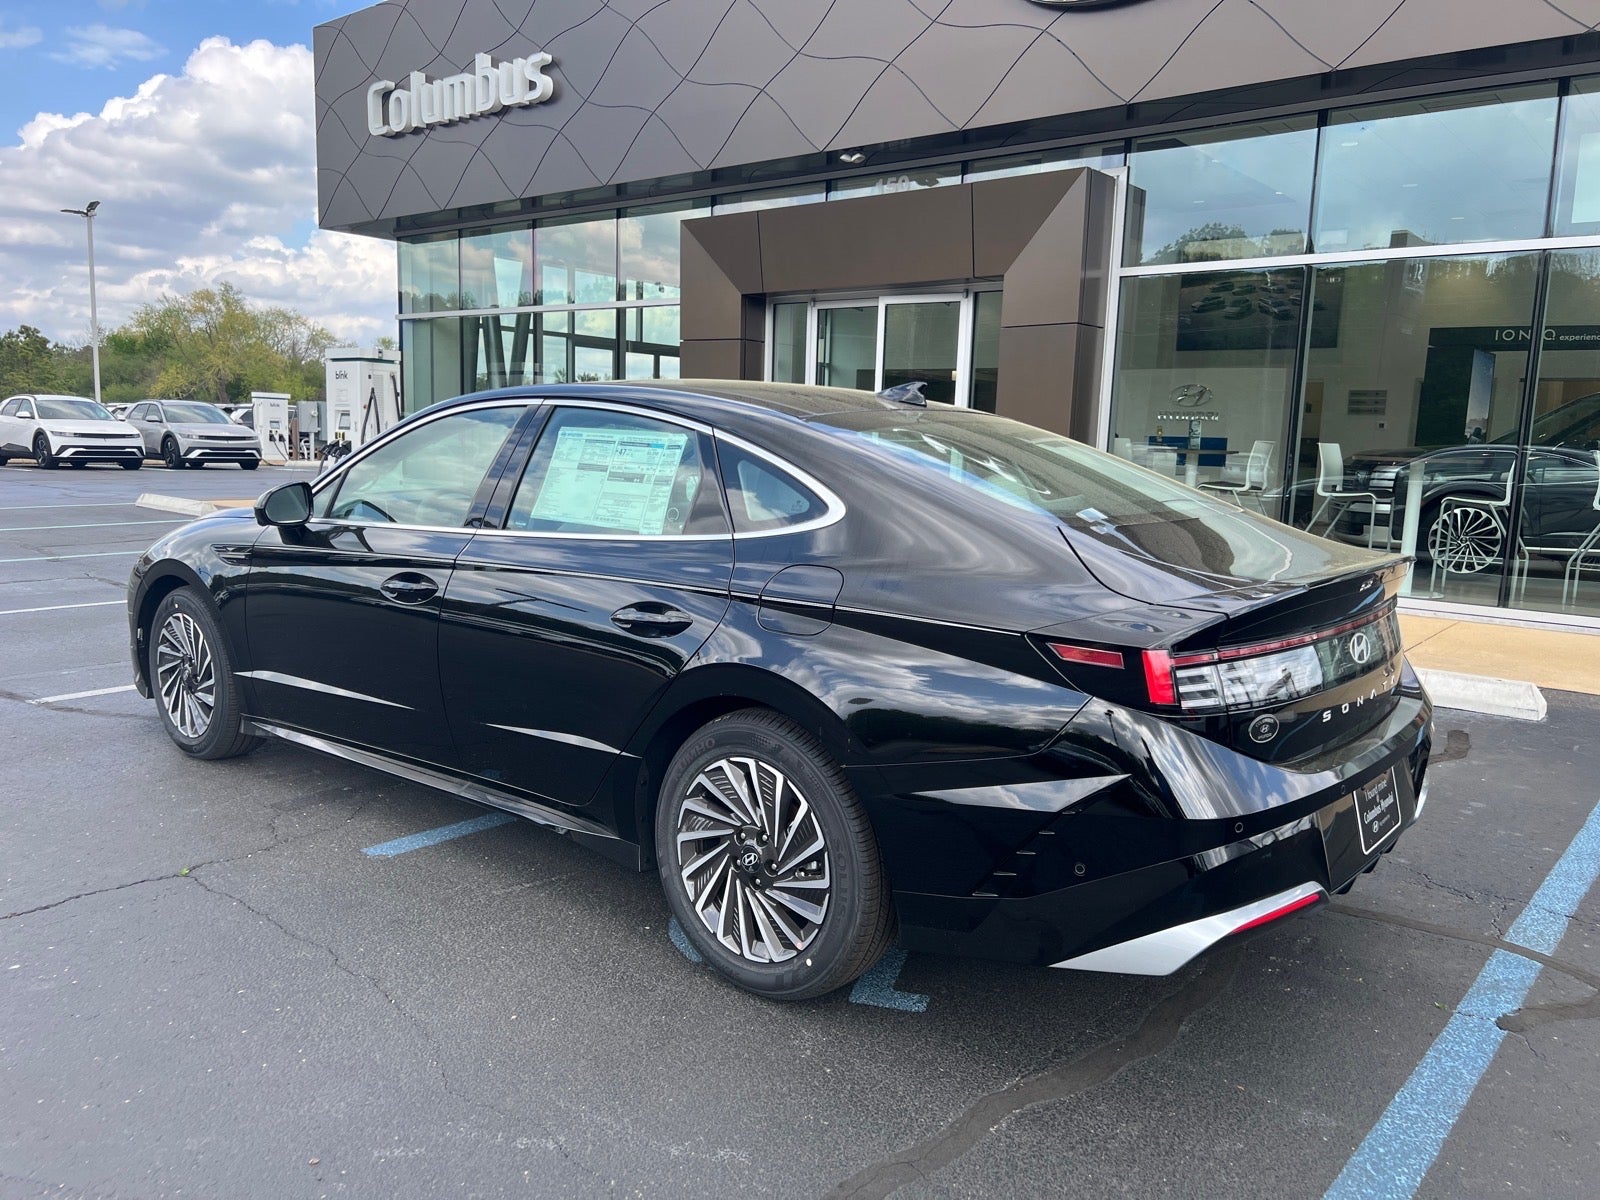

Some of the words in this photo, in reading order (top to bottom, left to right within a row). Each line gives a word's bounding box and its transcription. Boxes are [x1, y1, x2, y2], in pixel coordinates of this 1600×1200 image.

[367, 51, 554, 137] Columbus
[1494, 329, 1556, 341] IONQ
[335, 370, 349, 379] blink
[1322, 674, 1396, 723] SONATA
